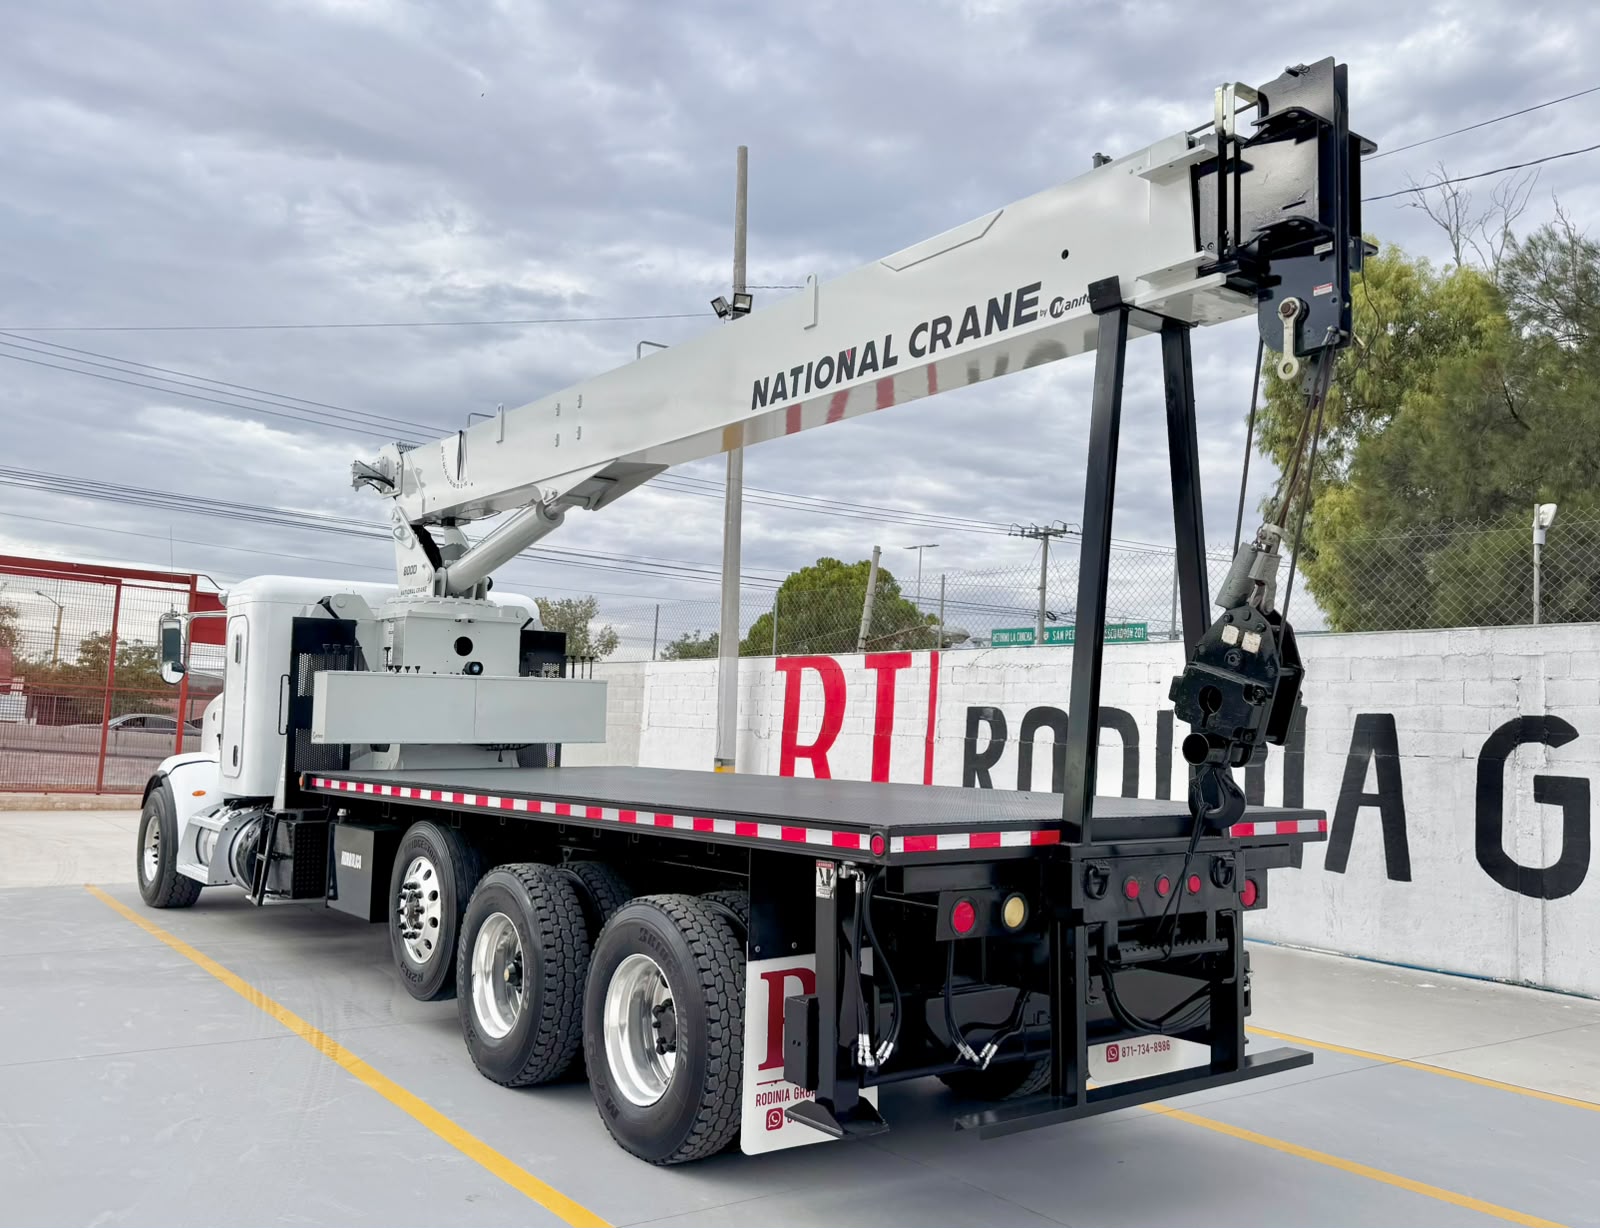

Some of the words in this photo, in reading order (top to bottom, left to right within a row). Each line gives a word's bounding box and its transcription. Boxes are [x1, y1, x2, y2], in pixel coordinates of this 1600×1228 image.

[751, 333, 899, 411] NATIONAL
[908, 281, 1042, 358] CRANE
[1052, 631, 1064, 641] SAN
[1133, 627, 1145, 638] 201
[1121, 1040, 1171, 1058] 871-734-8986
[755, 1088, 790, 1107] RODINIA
